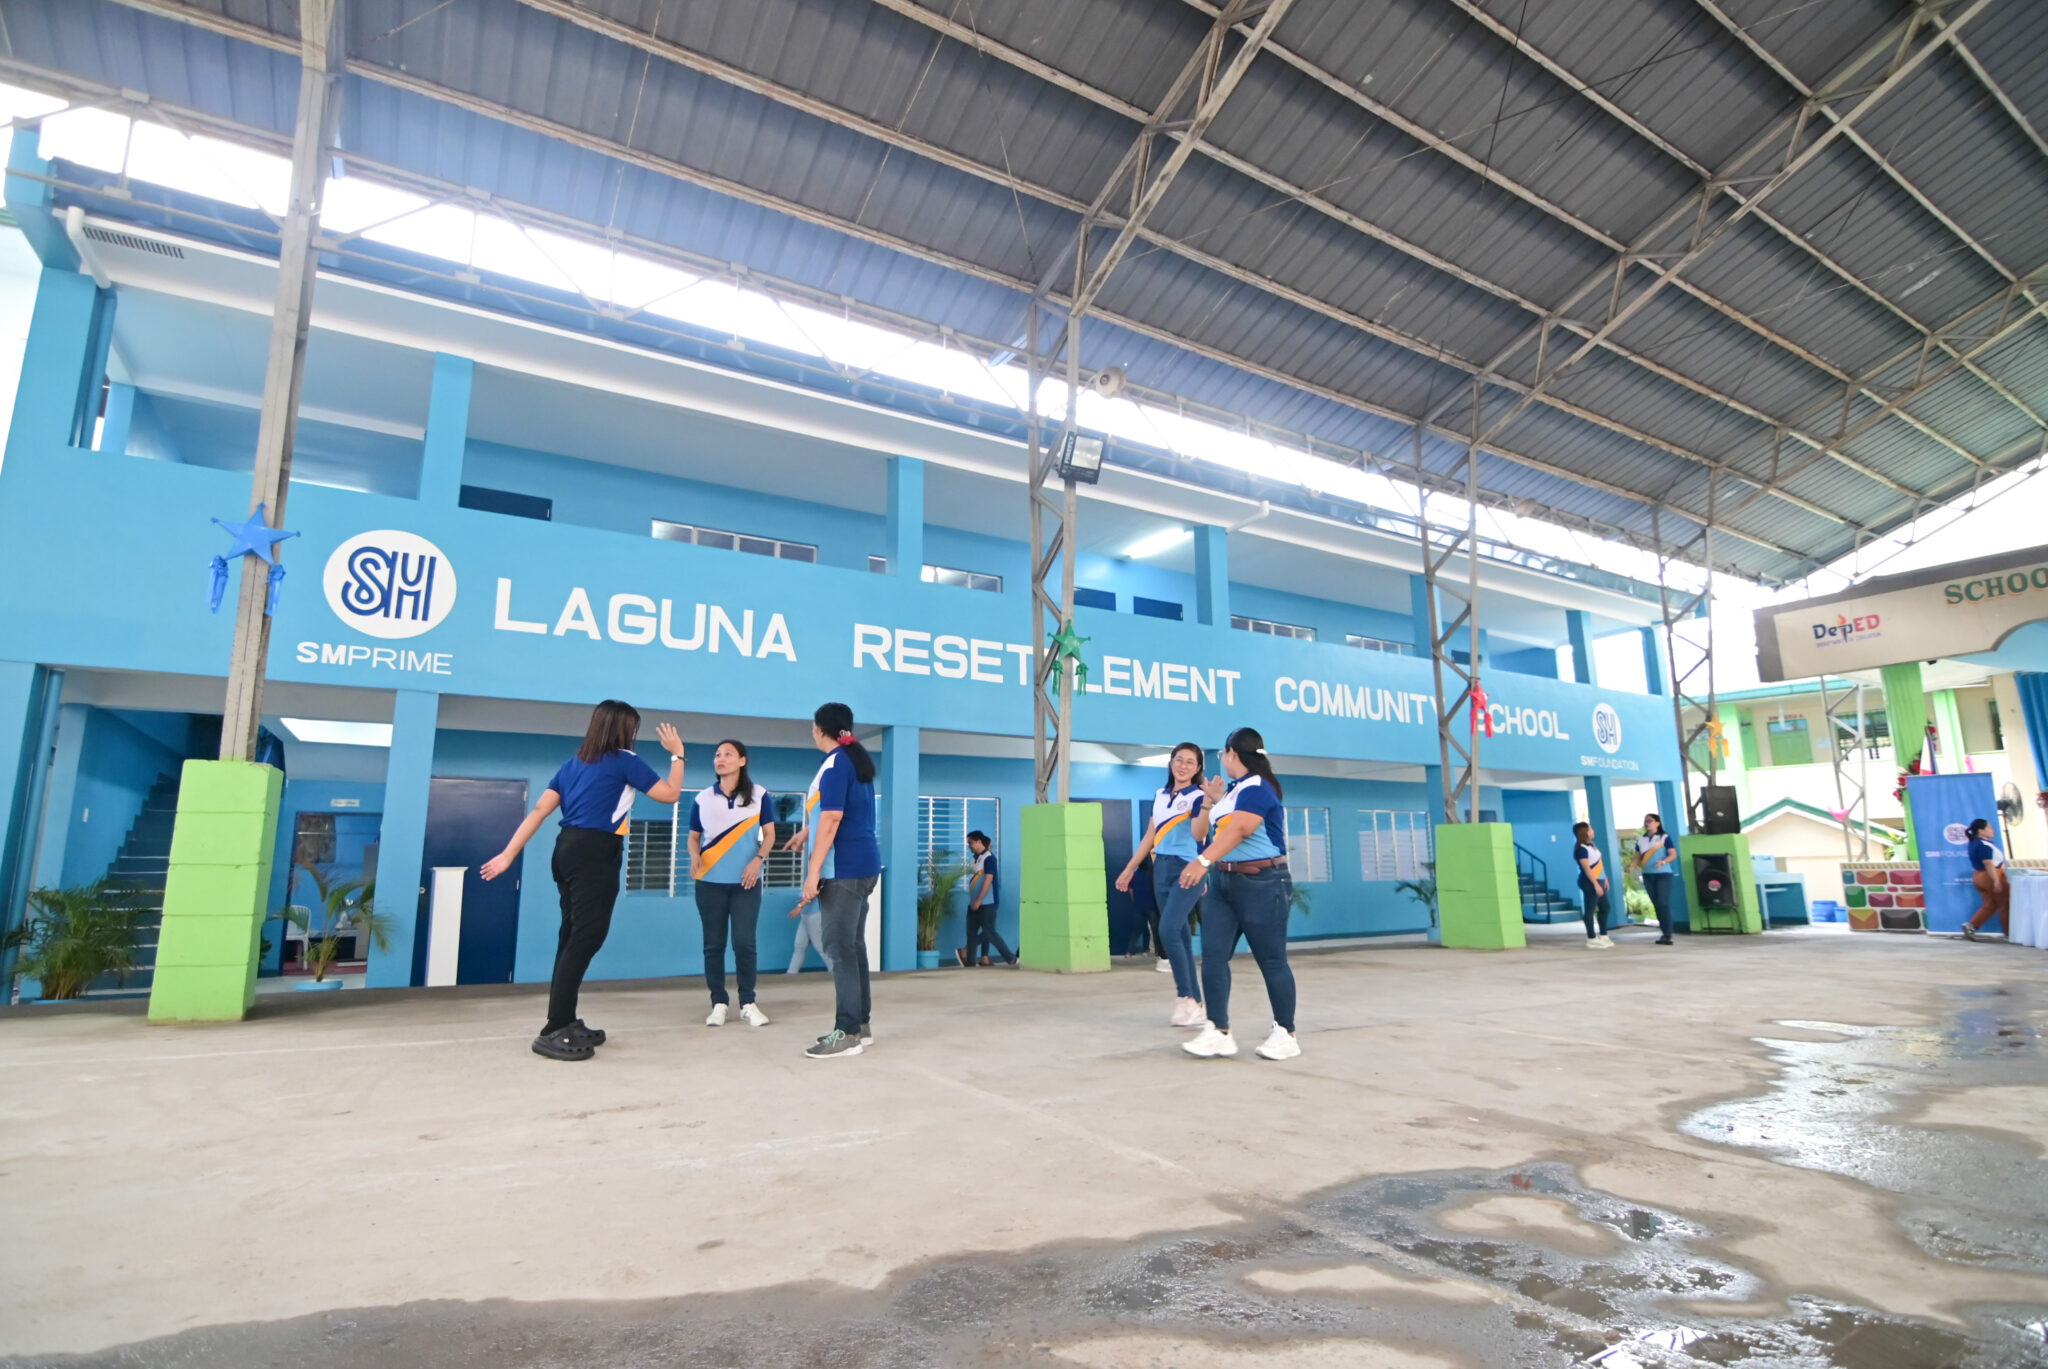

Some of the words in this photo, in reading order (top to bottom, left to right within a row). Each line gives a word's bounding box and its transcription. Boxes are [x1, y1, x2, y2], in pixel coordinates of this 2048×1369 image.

[494, 577, 798, 662] LAGUNA
[853, 623, 1241, 706] RESETLEMENT
[1812, 614, 1881, 643] DepED
